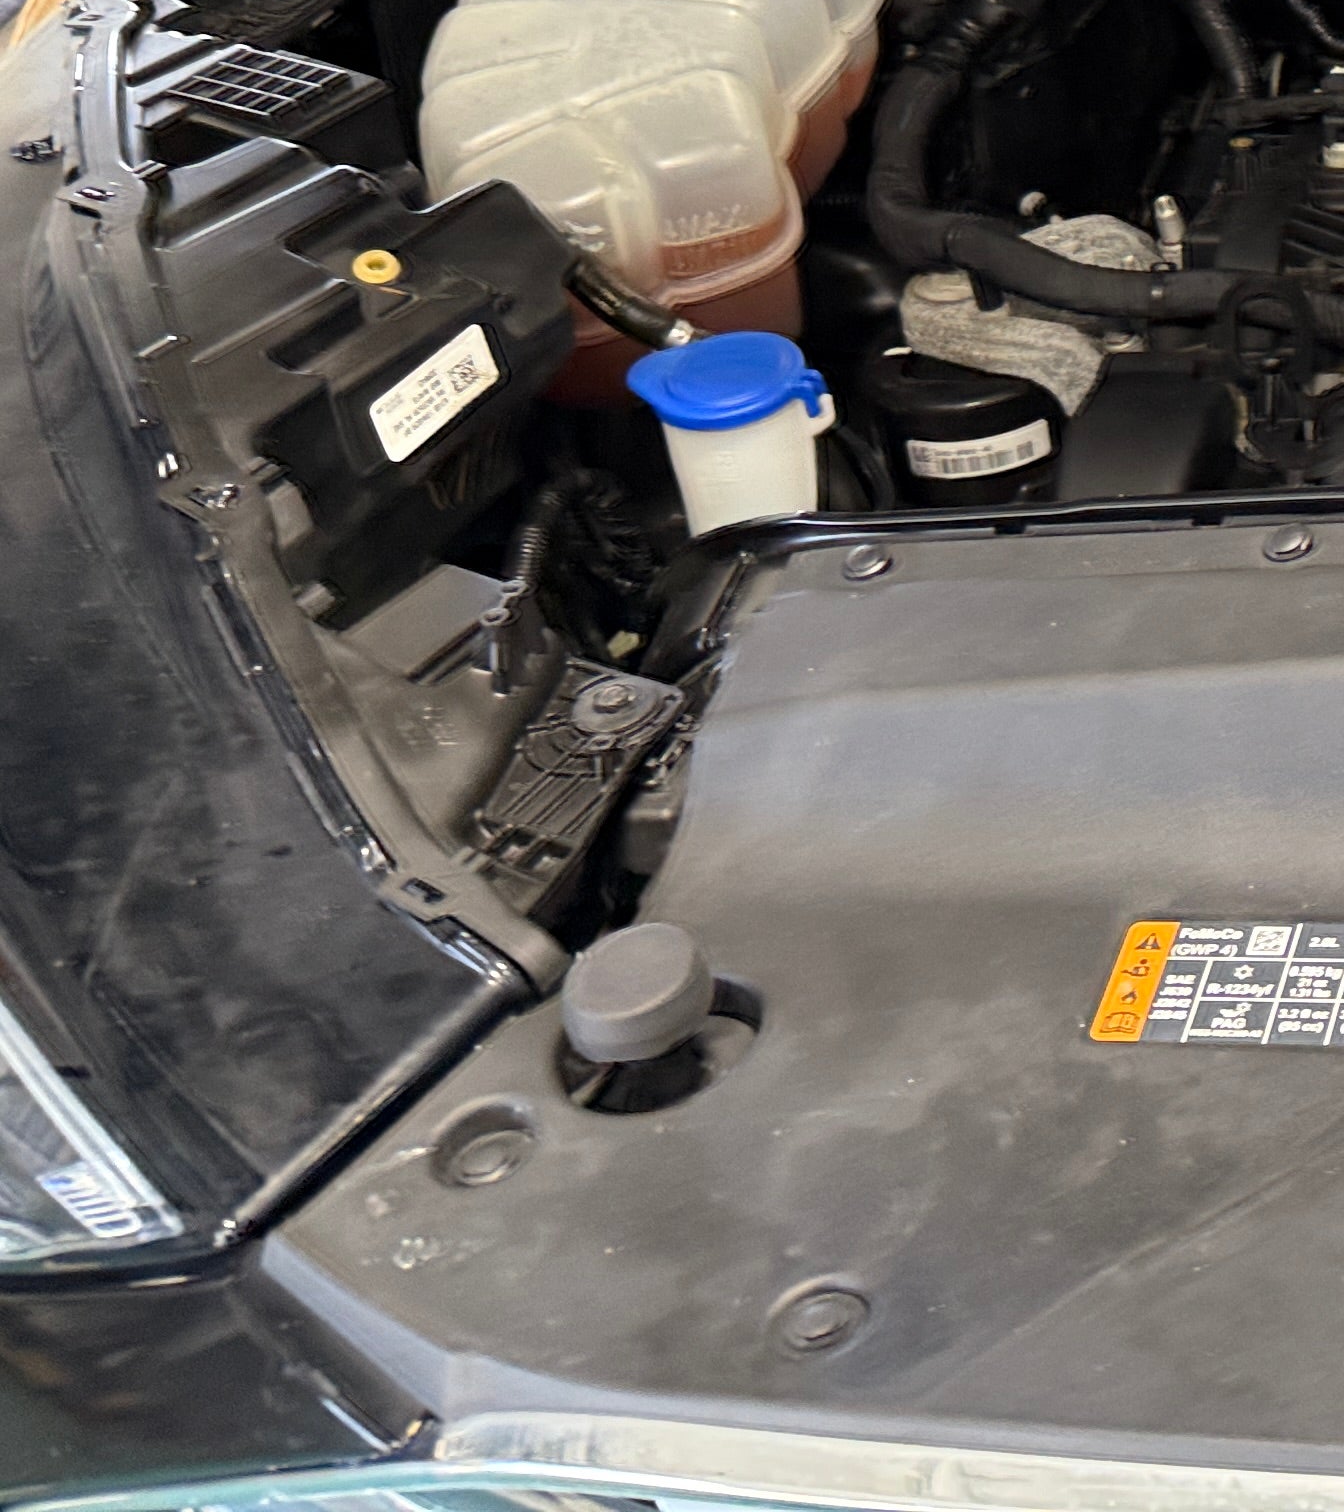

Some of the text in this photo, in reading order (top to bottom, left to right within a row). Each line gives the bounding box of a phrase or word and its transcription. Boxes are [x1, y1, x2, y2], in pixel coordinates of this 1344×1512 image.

[1178, 927, 1244, 940] FoMoCo
[1170, 943, 1239, 957] (GWP 4)
[1165, 974, 1197, 985] SAE
[1325, 966, 1344, 980] kg
[1205, 982, 1275, 999] R-1234yf
[1210, 1018, 1247, 1029] PAG
